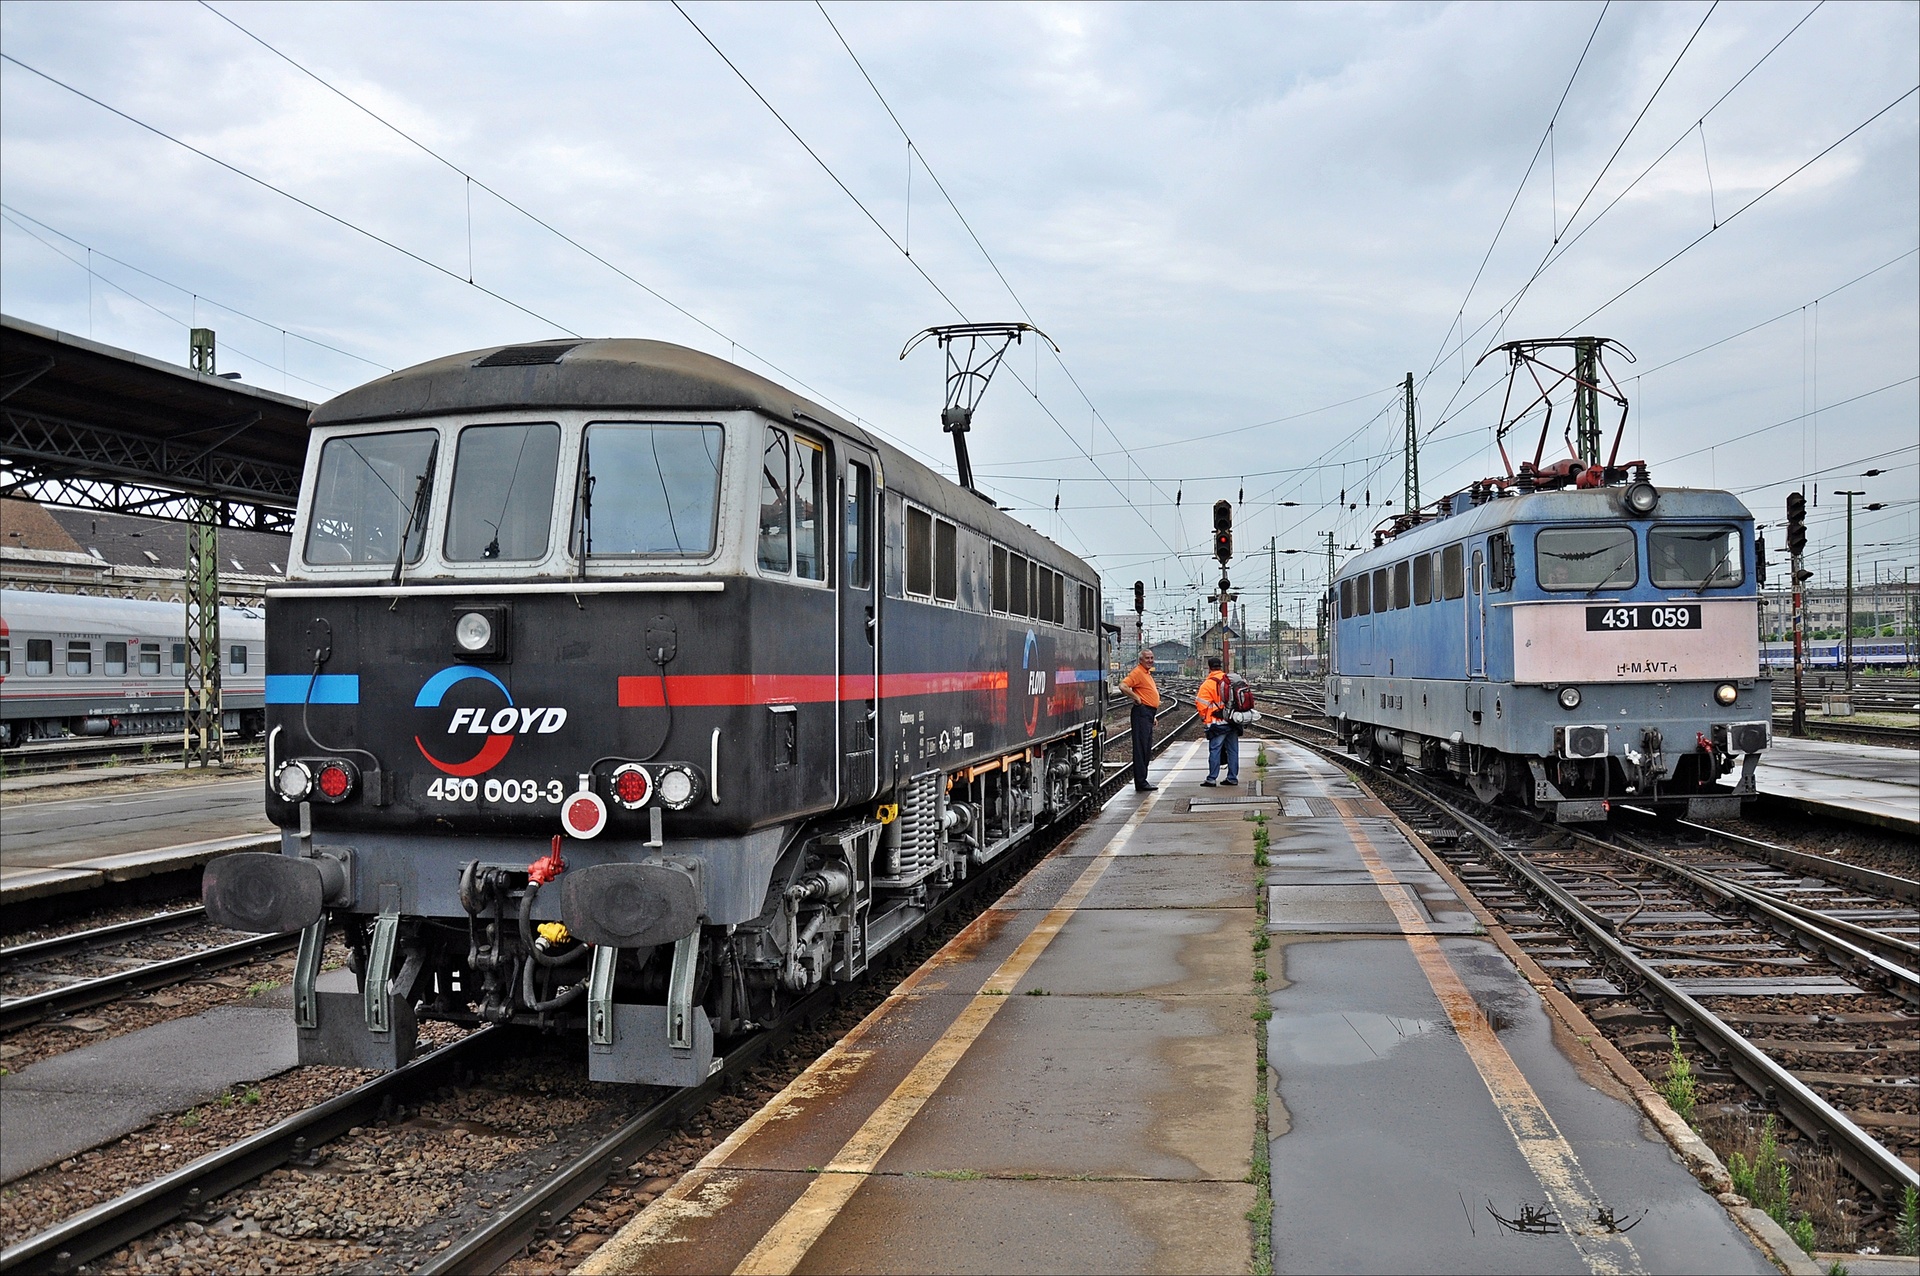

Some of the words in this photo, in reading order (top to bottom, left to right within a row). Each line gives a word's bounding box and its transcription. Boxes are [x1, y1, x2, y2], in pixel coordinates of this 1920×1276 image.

[1602, 608, 1639, 628] 431
[1651, 607, 1690, 628] 059
[1028, 670, 1046, 695] FLOYD
[447, 707, 568, 734] FLOYD
[427, 778, 479, 802] 450
[484, 779, 564, 804] 003-3
